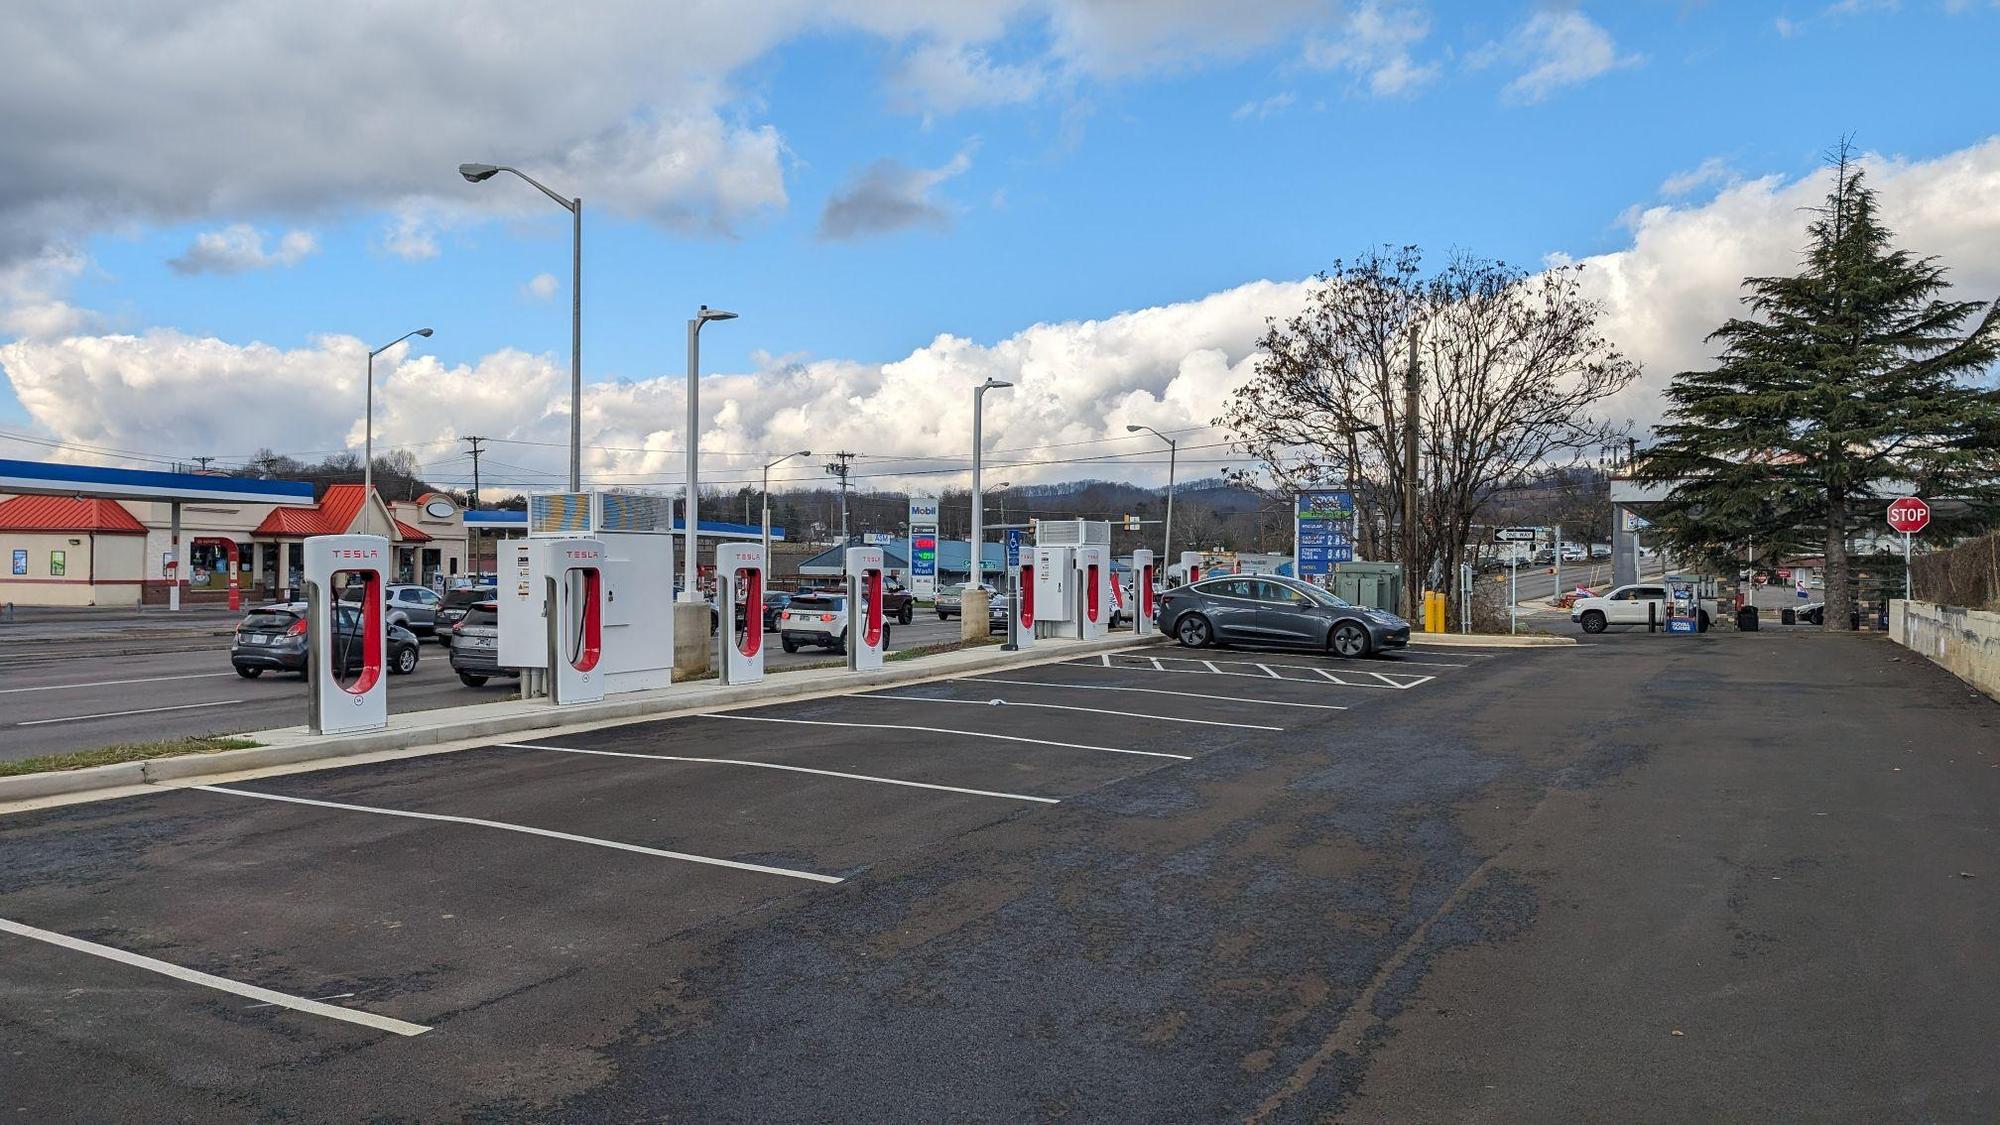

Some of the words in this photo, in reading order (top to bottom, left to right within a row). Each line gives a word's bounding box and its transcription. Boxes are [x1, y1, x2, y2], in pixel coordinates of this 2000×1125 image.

[912, 506, 935, 514] Mobil
[1890, 509, 1926, 521] STOP
[332, 550, 378, 559] TESLA
[566, 551, 599, 559] TESLA
[736, 553, 760, 561] TESLA
